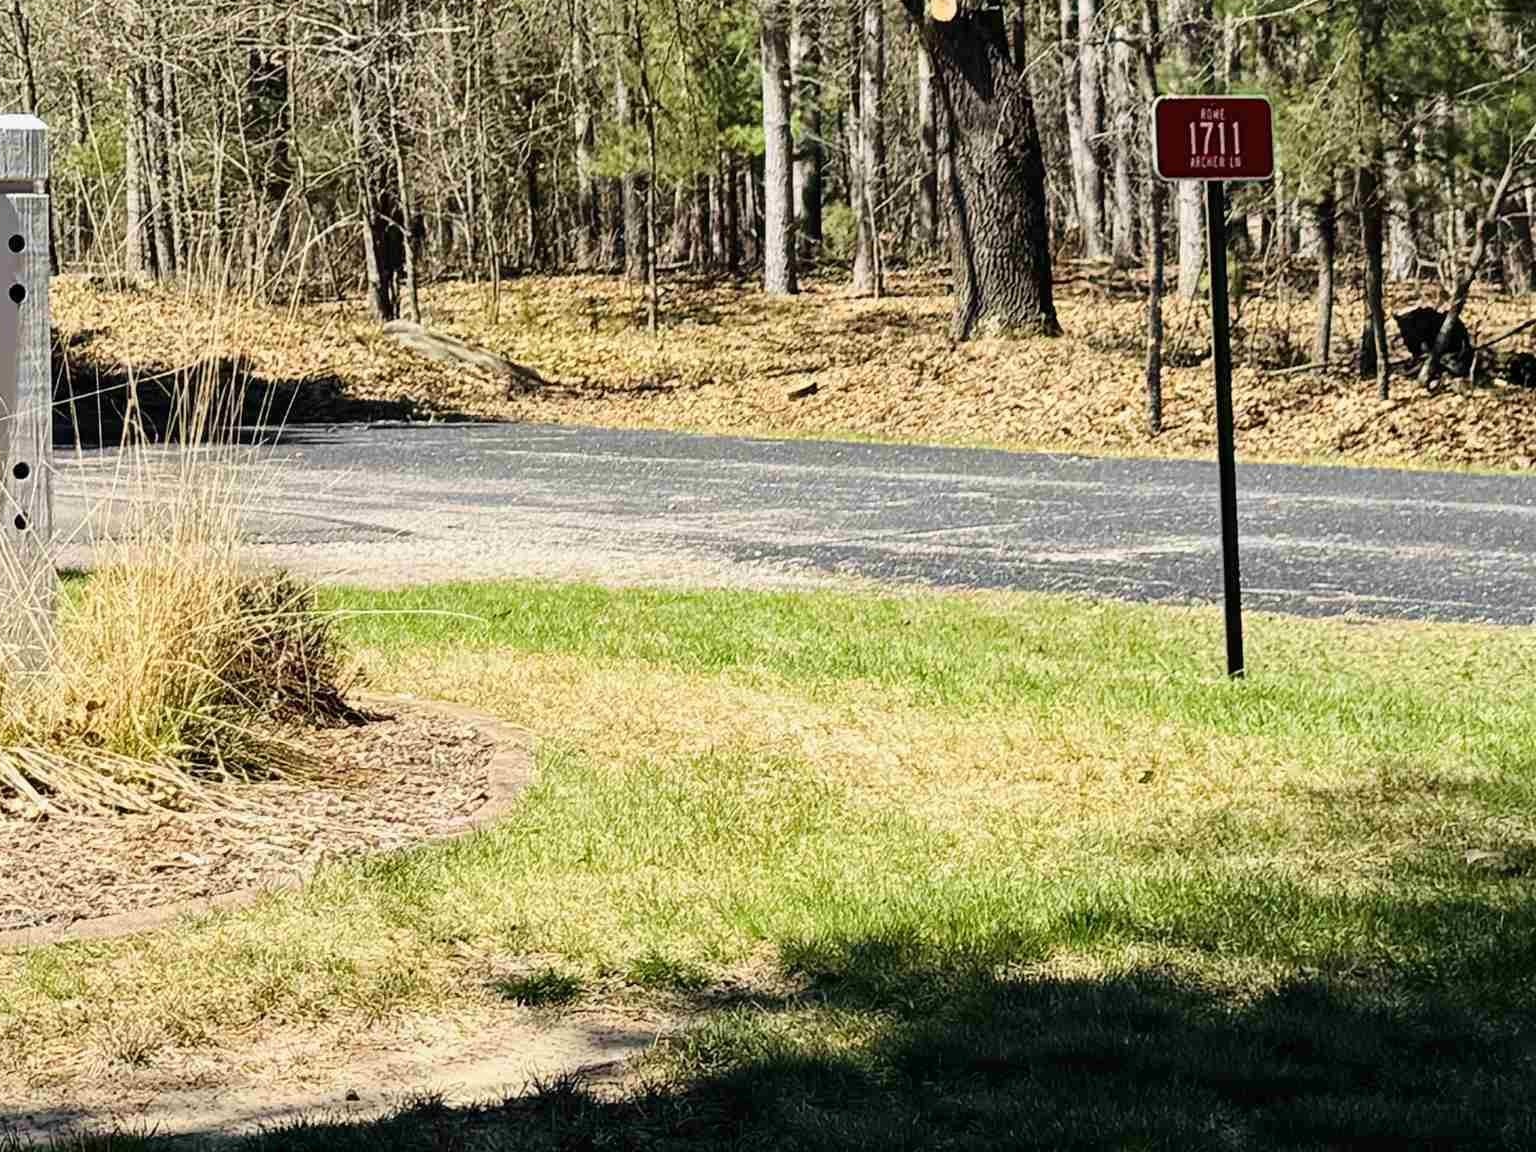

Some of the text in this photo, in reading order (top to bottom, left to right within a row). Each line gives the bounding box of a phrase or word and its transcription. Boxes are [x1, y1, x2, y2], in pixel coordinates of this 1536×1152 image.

[1200, 108, 1225, 121] ROME
[1189, 121, 1240, 155] 1711
[1190, 156, 1242, 169] ARCHER LN
